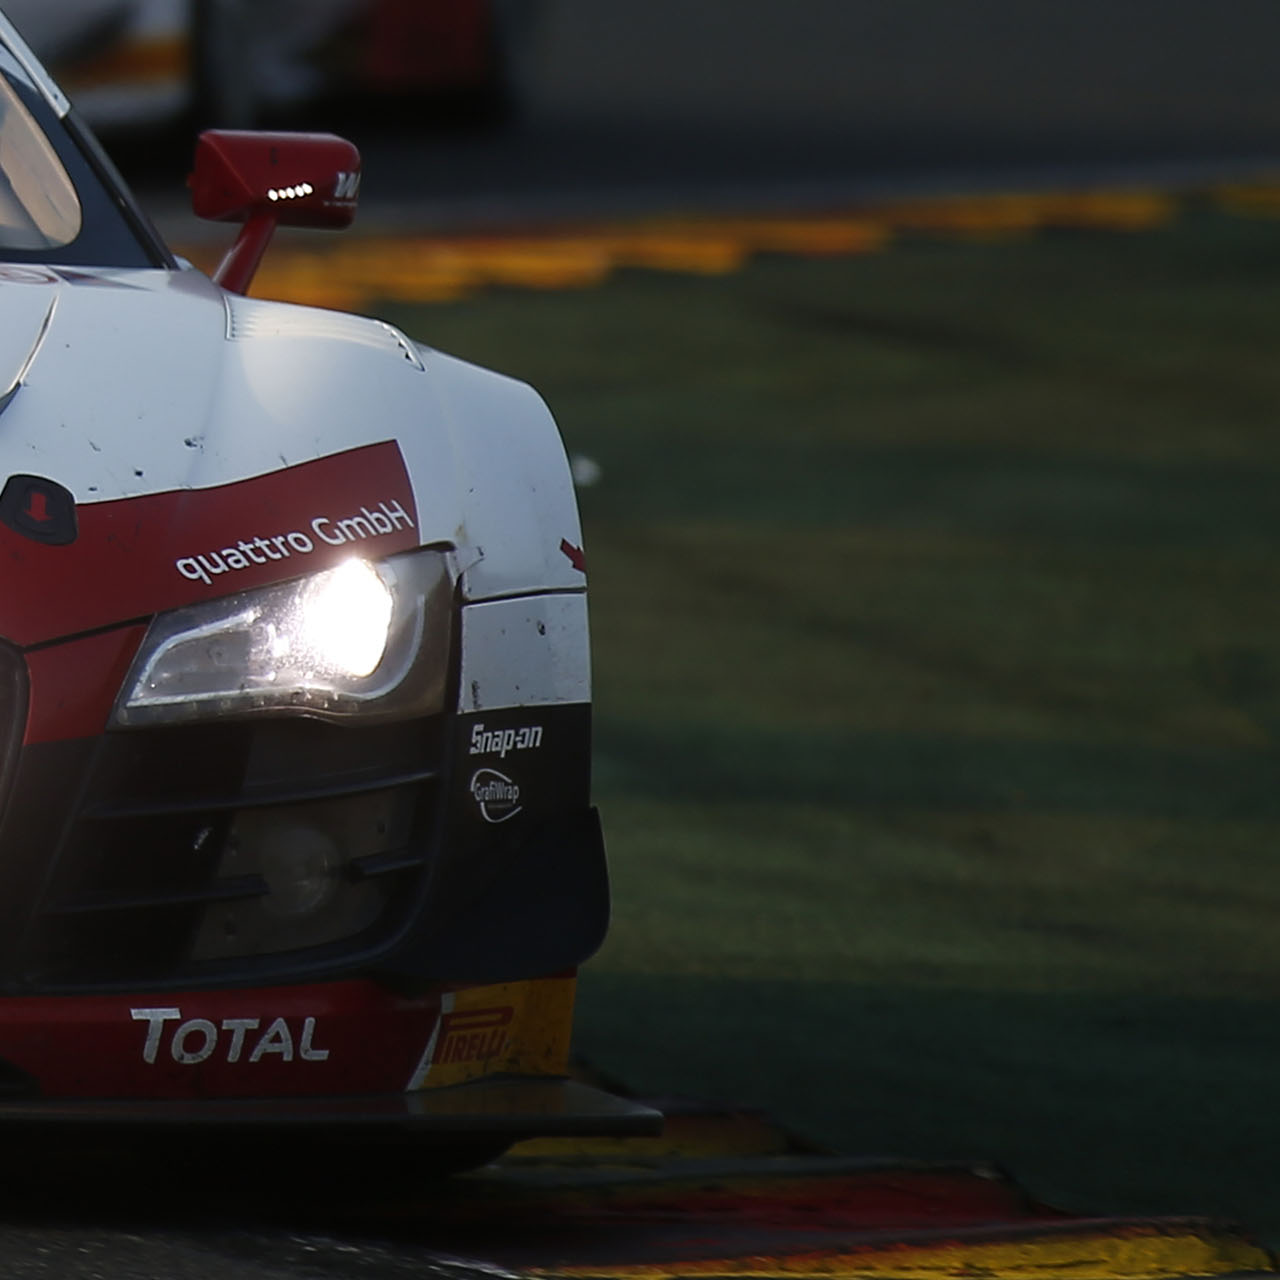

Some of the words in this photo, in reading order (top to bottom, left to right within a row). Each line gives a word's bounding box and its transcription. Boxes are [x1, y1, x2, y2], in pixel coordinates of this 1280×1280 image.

[175, 526, 314, 586] quattro
[311, 498, 414, 551] GmbH
[469, 723, 543, 758] Snap-on
[130, 1006, 331, 1065] TOTAL
